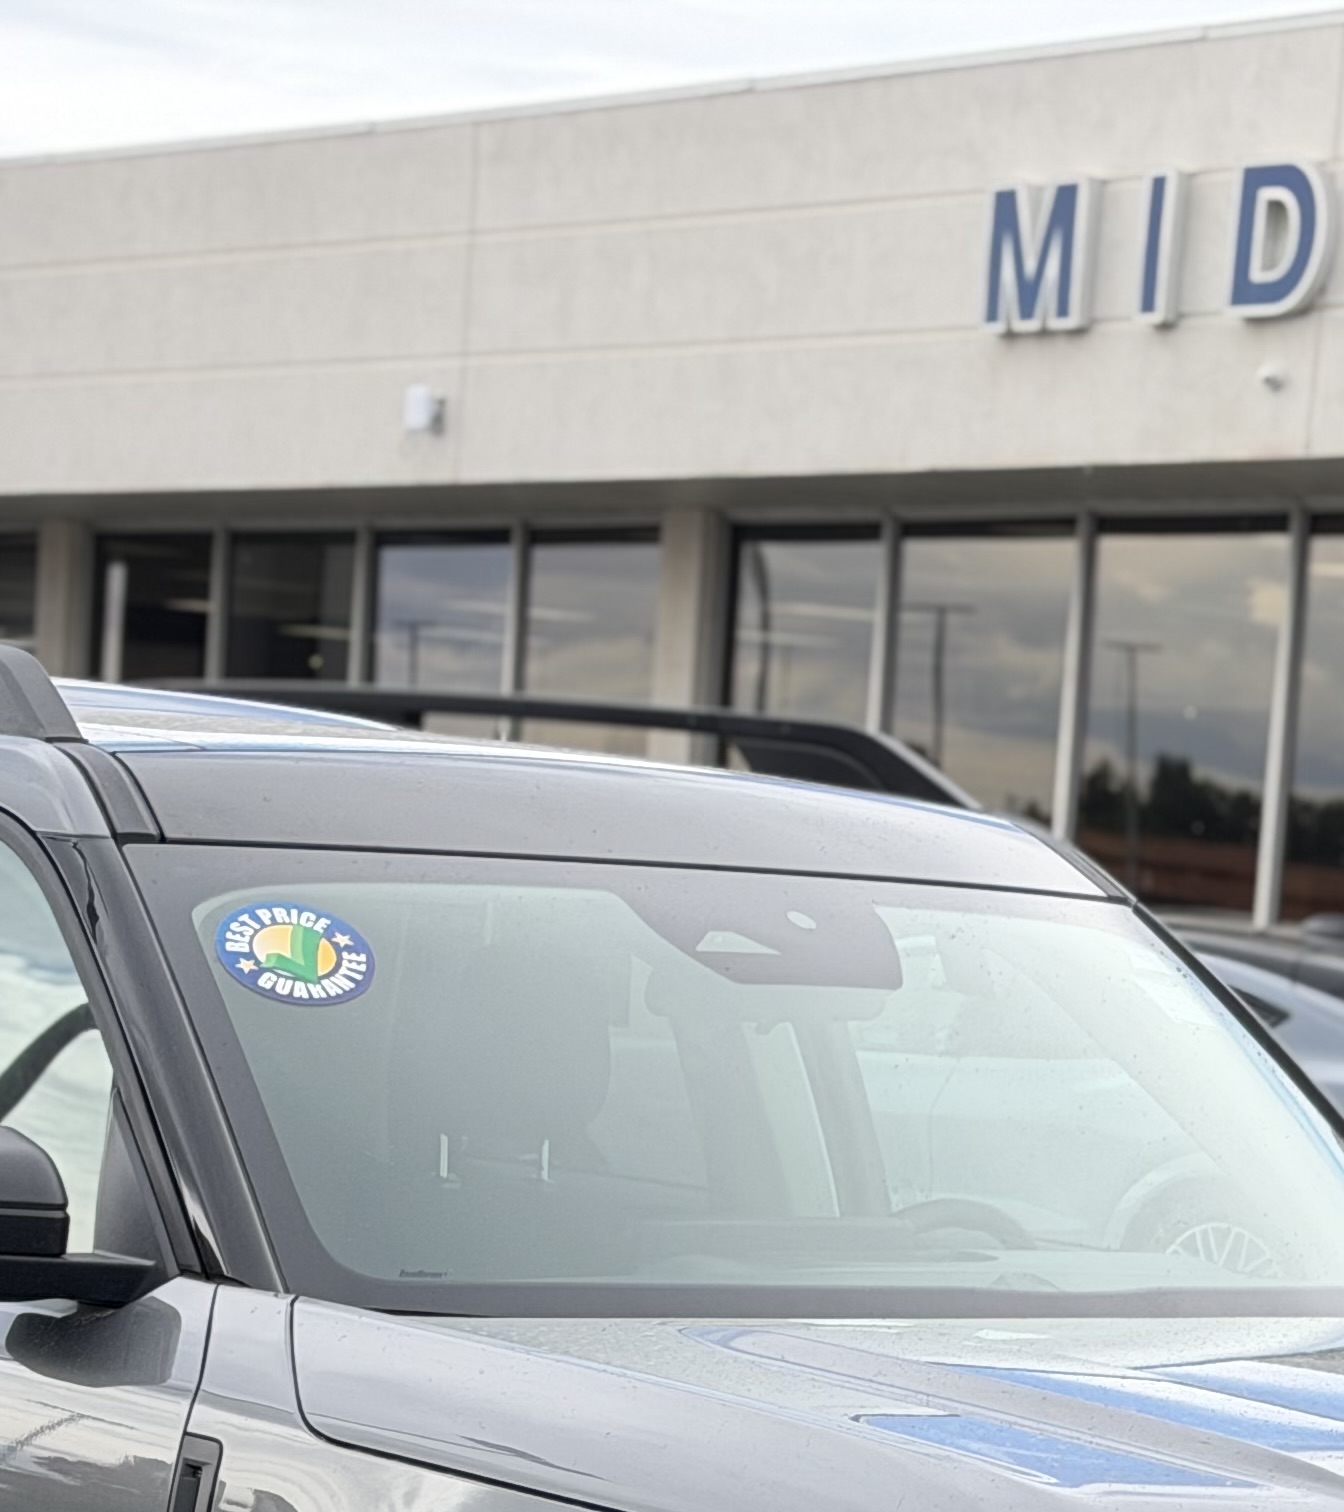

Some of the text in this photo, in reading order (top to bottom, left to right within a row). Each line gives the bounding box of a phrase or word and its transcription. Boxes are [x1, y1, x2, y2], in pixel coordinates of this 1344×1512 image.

[225, 907, 331, 953] BEST PRICE
[257, 951, 366, 999] GUARANTEE
